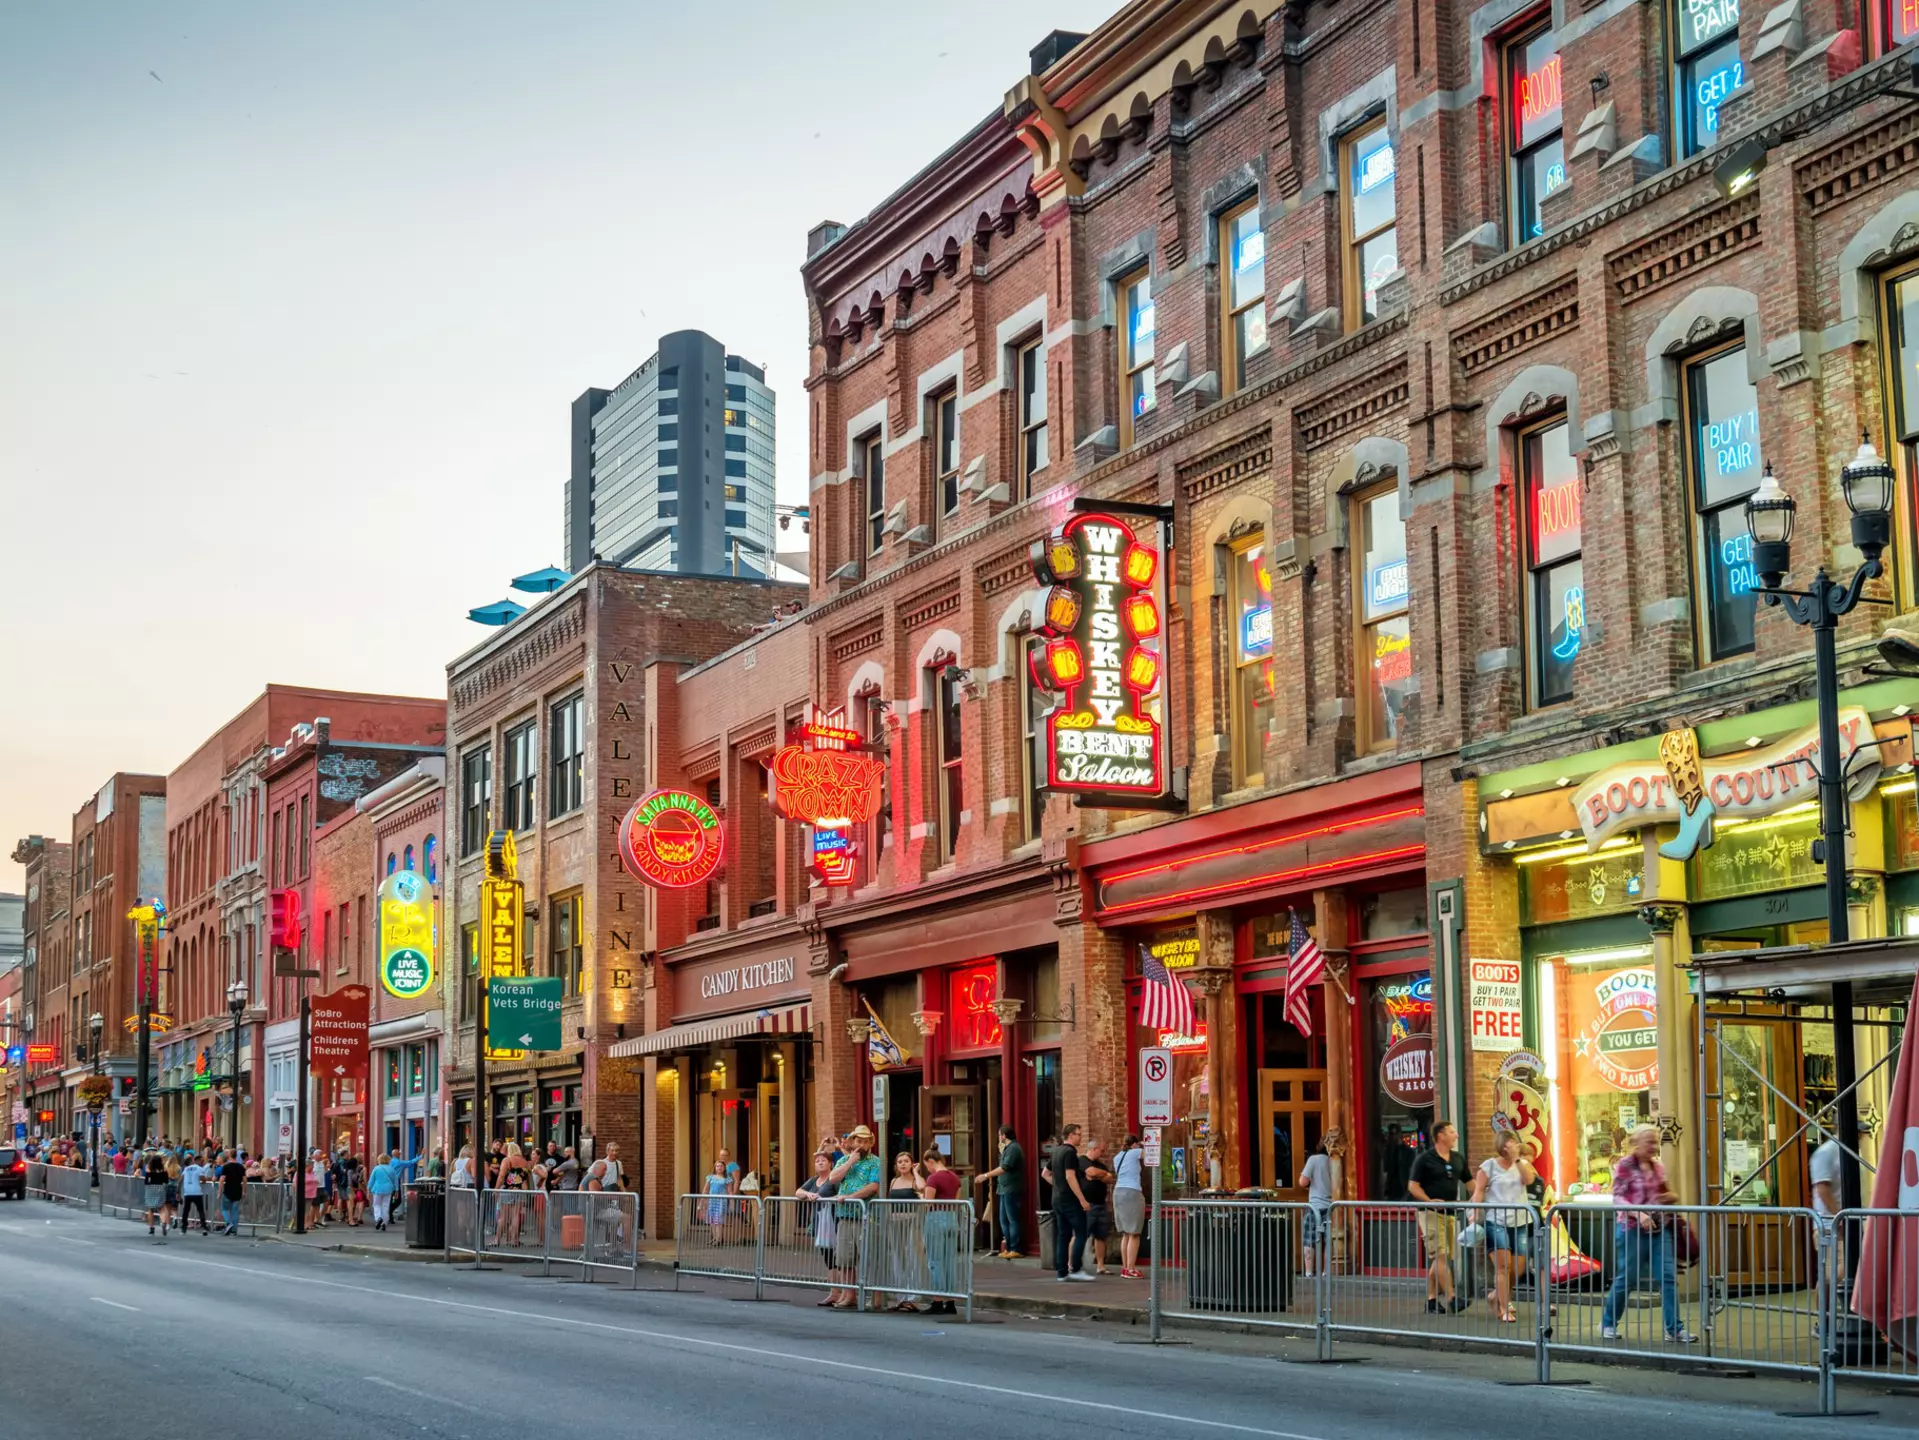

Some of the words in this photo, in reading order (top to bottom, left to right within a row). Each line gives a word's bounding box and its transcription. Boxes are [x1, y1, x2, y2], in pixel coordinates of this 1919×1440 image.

[1694, 0, 1740, 40] PAIR
[1698, 71, 1728, 104] GET
[1733, 62, 1742, 89] 2
[1710, 416, 1743, 449] BUY
[1748, 411, 1757, 435] 1
[1718, 442, 1753, 476] PAIR
[1723, 533, 1752, 565] GET
[1127, 550, 1152, 583] WB
[1731, 564, 1759, 594] PAI
[1375, 578, 1408, 602] LIGH
[1050, 596, 1075, 627] WB
[1083, 525, 1123, 726] WHISKEY
[1129, 604, 1156, 633] WB
[1051, 651, 1078, 680] WB
[1130, 655, 1155, 686] WB
[1057, 729, 1153, 759] BENT
[774, 746, 885, 789] CRAZY
[1058, 754, 1154, 785] Saloon
[1586, 775, 1670, 827] BOOT
[1710, 717, 1861, 807] COUNTY
[636, 793, 717, 829] SAVANNAH'S
[777, 785, 872, 822] TOWN
[816, 830, 838, 842] LIVE
[634, 840, 669, 880] CANDY
[672, 843, 718, 883] KITCHEN
[495, 881, 513, 889] the
[397, 959, 418, 969] LIVE
[1152, 943, 1186, 957] WHISKEY
[1163, 953, 1195, 967] SALOON
[391, 969, 424, 979] MUSIC
[701, 968, 739, 999] CANDY
[741, 957, 795, 990] KITCHEN
[1476, 965, 1517, 981] BOOTS
[492, 984, 534, 995] Korean
[1387, 985, 1412, 998] BUD
[1473, 997, 1486, 1006] GET
[1487, 997, 1504, 1007] TWO
[1504, 998, 1520, 1008] PAIR
[1477, 986, 1492, 995] BUY
[1500, 986, 1517, 997] PAIR
[1598, 972, 1657, 1004] BOOT
[315, 1009, 342, 1018] SoBro
[493, 998, 518, 1008] Vets
[523, 998, 562, 1012] Bridge
[1591, 1005, 1612, 1034] BUY
[314, 1020, 367, 1029] Attractions
[1473, 1010, 1521, 1037] FREE
[314, 1036, 359, 1046] Childrens
[314, 1046, 350, 1056] Theatre
[1607, 1033, 1632, 1049] YOU
[1634, 1030, 1657, 1046] GET
[1386, 1050, 1426, 1081] WHISKEY
[1592, 1053, 1617, 1082] TWO
[1619, 1069, 1648, 1088] PAIR
[1398, 1081, 1434, 1091] SALOO
